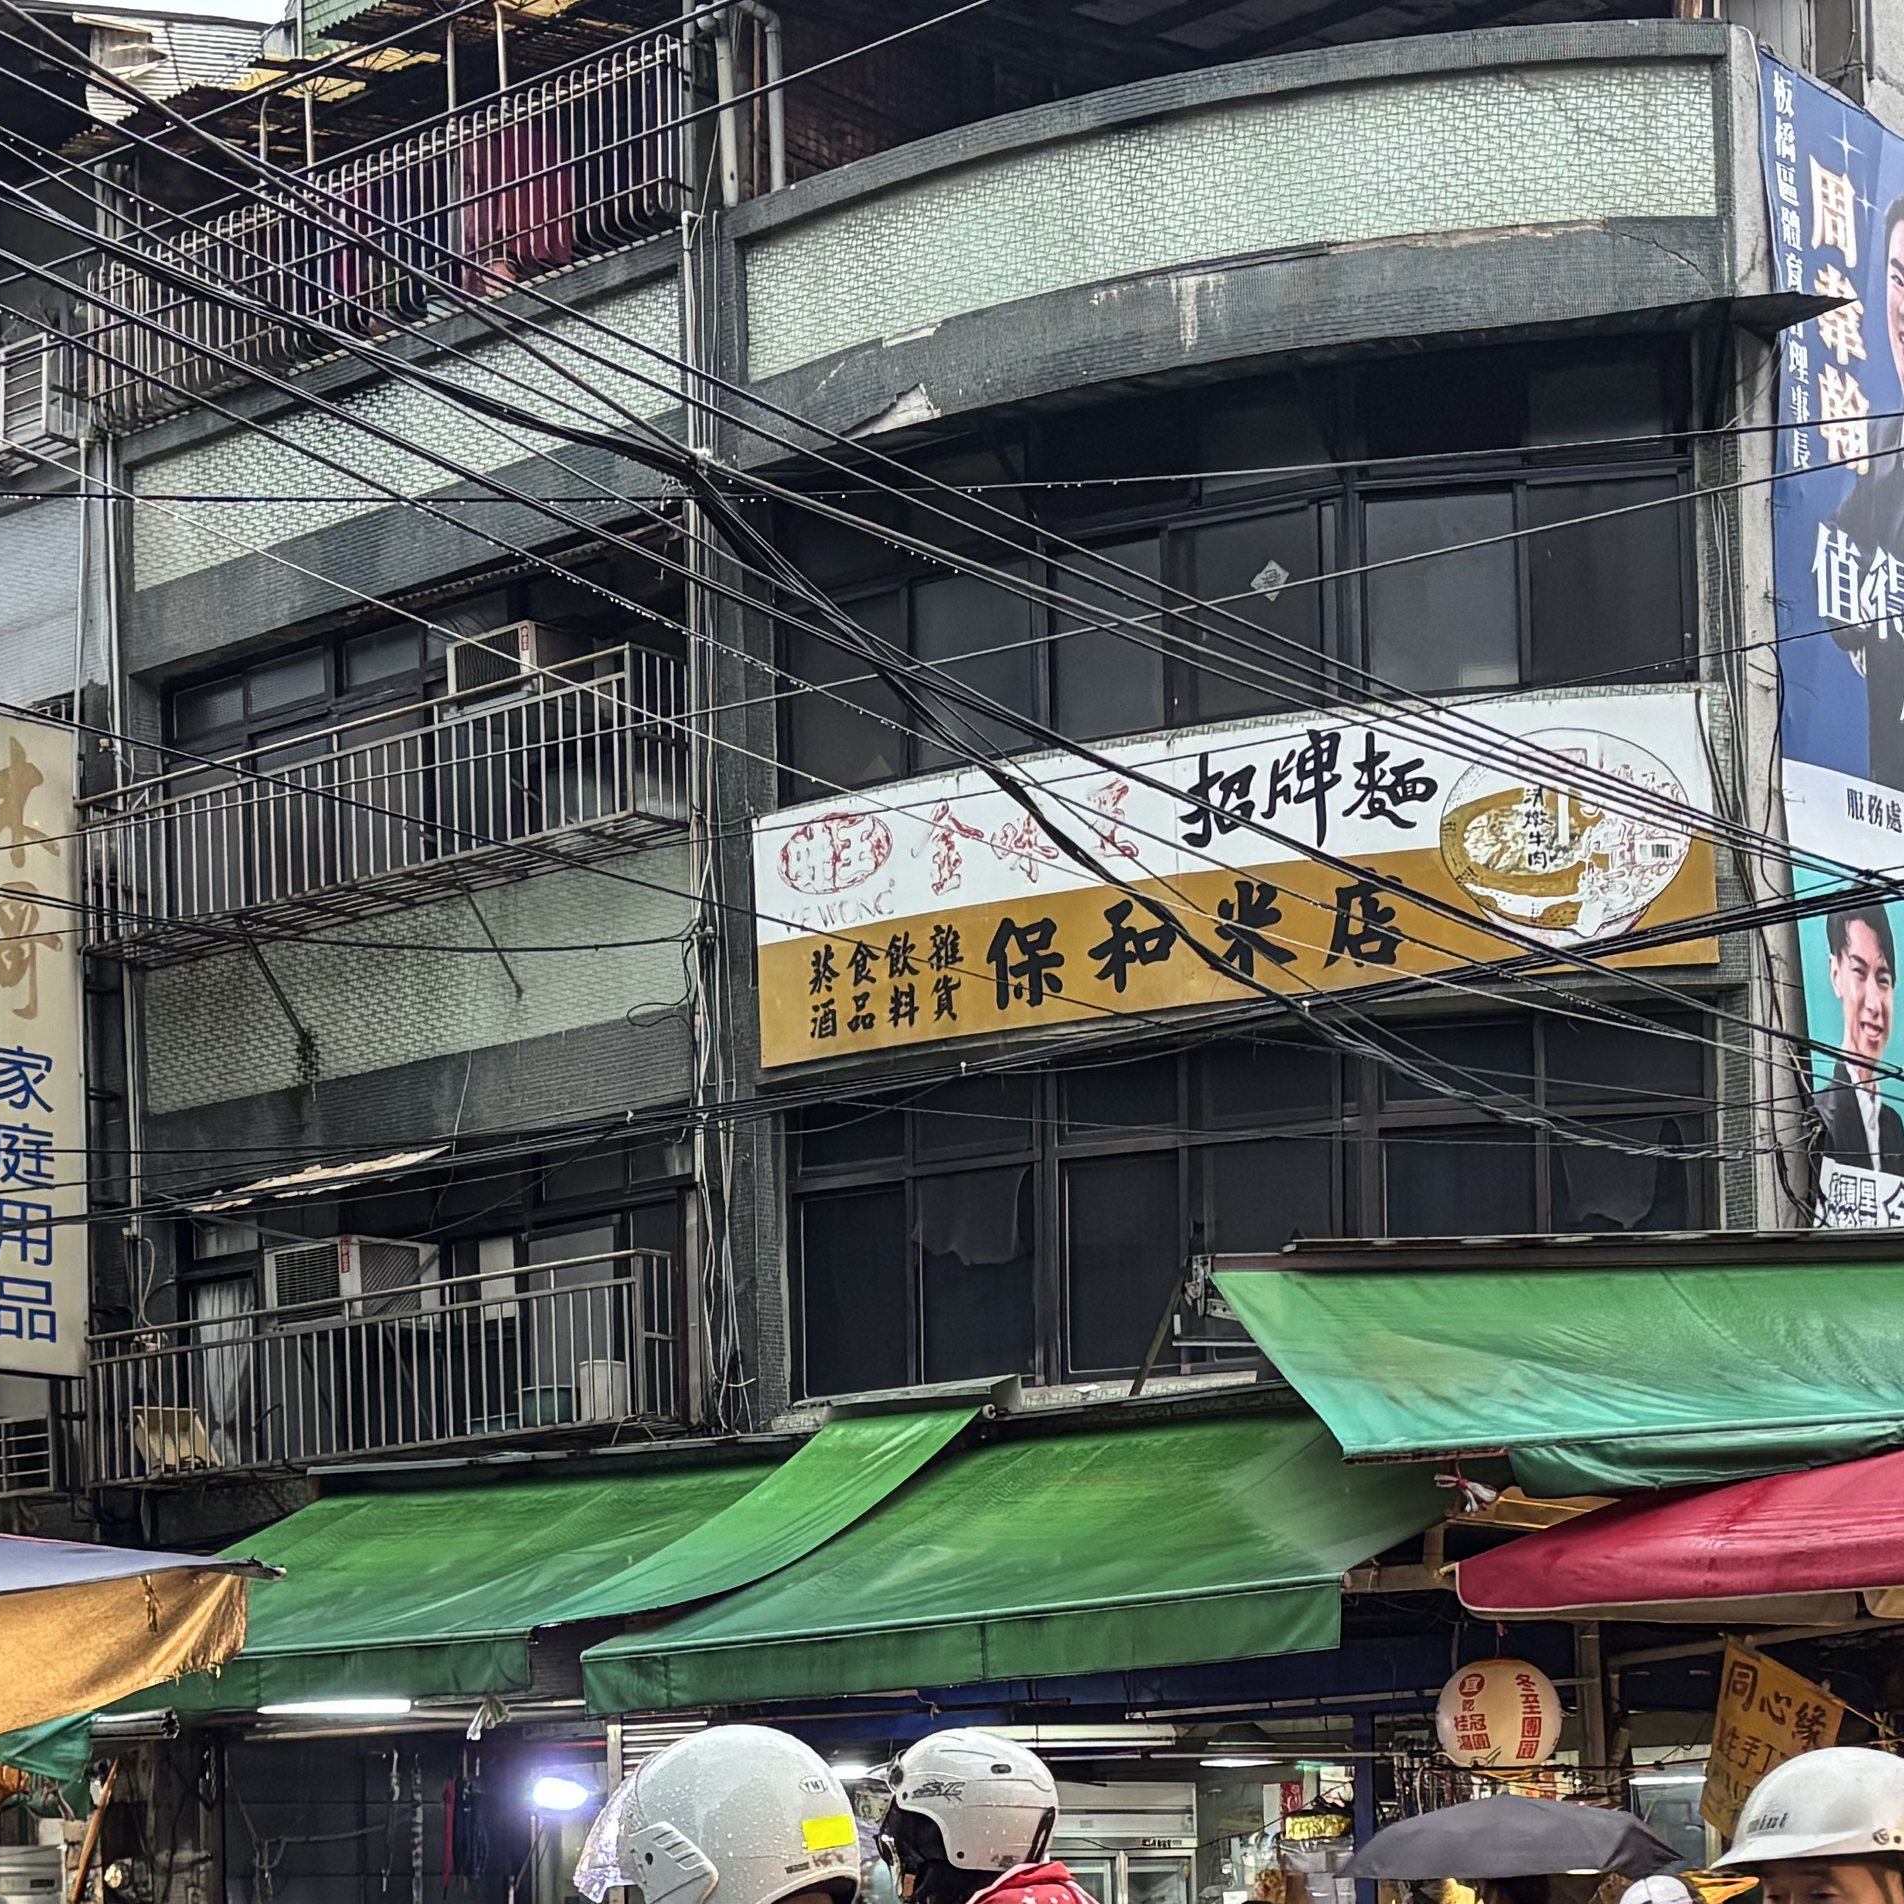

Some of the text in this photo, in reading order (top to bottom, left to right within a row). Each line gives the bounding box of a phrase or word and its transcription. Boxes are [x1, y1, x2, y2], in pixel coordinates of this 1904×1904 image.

[1179, 728, 1439, 850] 招牌麵
[846, 939, 881, 1033] 食品
[884, 929, 921, 1029] 飲料
[927, 922, 964, 1024] 雜貨
[985, 864, 1410, 1011] 保和米店
[1515, 1673, 1542, 1760] 冬至團圓
